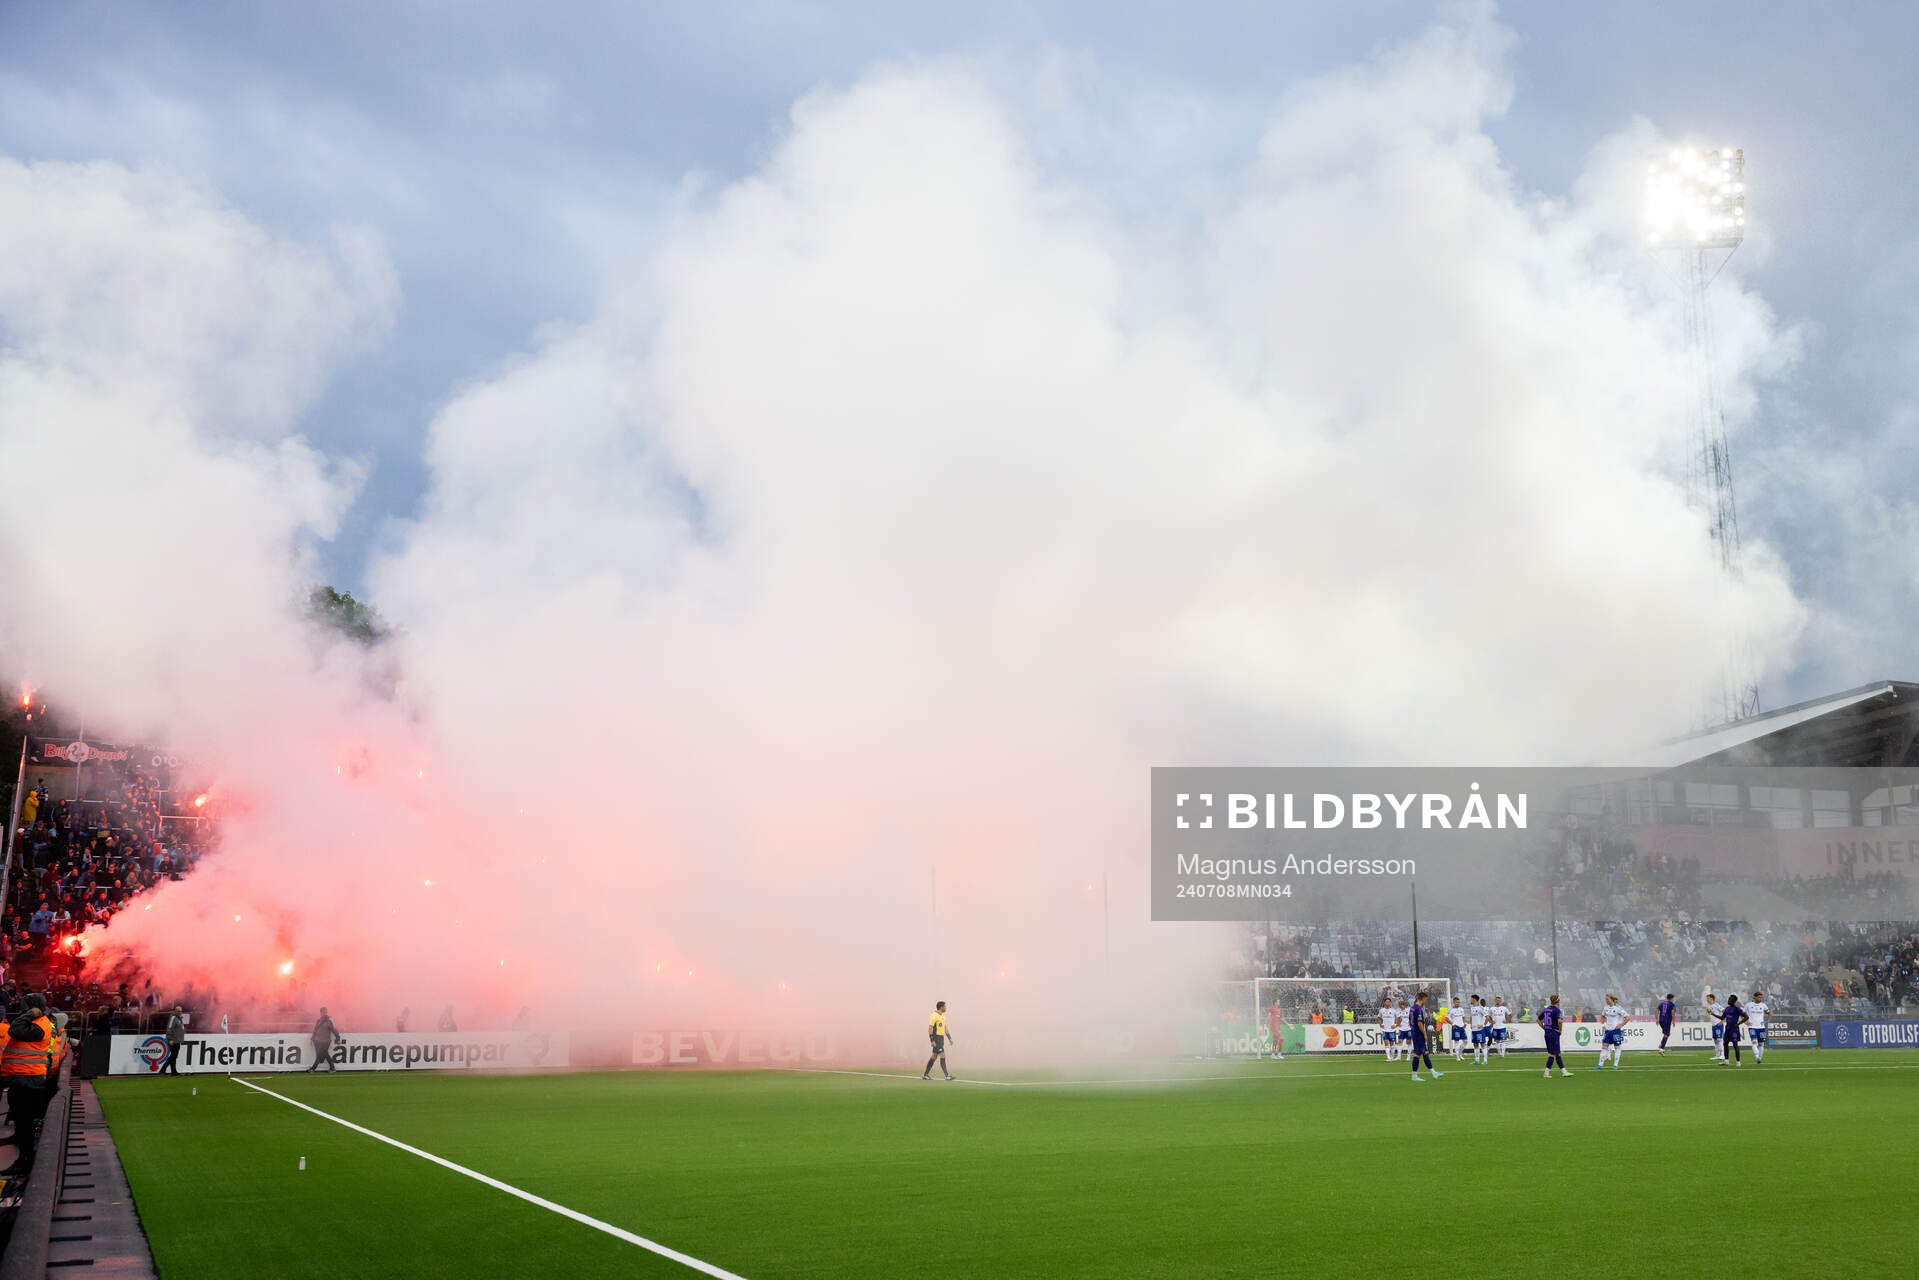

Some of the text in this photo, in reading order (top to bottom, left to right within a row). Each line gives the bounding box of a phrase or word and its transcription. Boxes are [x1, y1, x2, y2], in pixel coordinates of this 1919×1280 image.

[1344, 1029, 1363, 1045] DS
[1594, 1029, 1645, 1037] LUERGS
[133, 1047, 162, 1055] Thermia
[181, 1039, 510, 1068] Thermia ärmepumpar
[631, 1031, 836, 1064] BEVEGO
